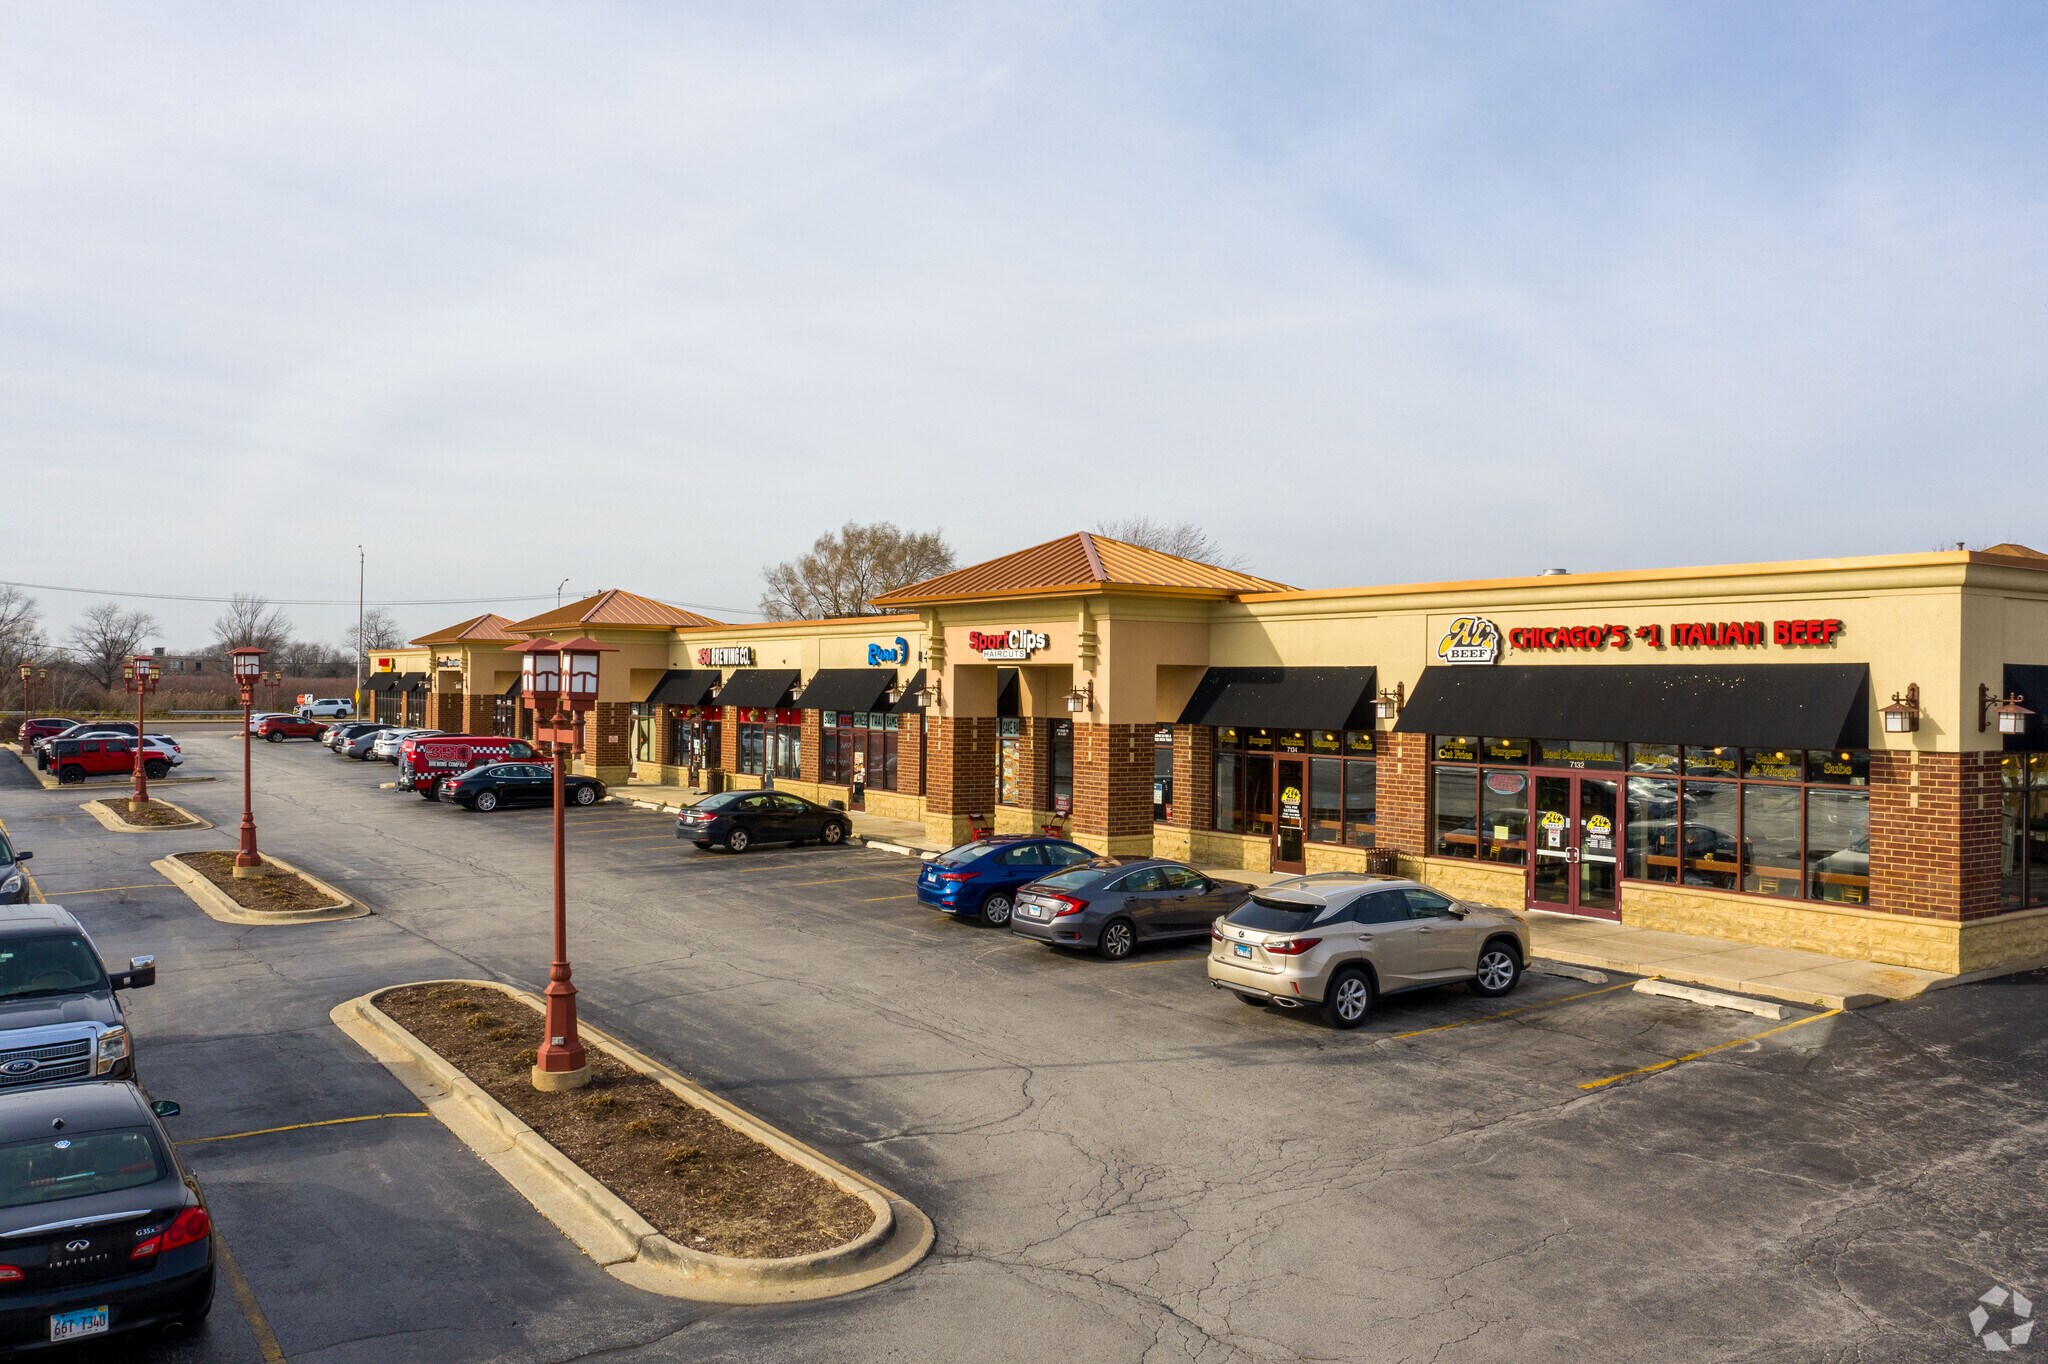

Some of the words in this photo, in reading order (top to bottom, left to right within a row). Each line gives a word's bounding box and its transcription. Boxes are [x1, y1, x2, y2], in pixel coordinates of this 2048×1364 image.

[1449, 617, 1495, 649] Al's
[1508, 624, 1626, 649] CHICAGO'S
[1634, 623, 1661, 647] #1
[1670, 620, 1761, 647] ITALIAN
[1773, 618, 1839, 645] BEEF
[711, 647, 739, 665] BREWING
[983, 650, 1025, 658] HAIRCUTS
[1450, 649, 1488, 659] BEEF
[871, 714, 883, 727] THAI
[886, 715, 898, 728] RAME
[1280, 736, 1304, 747] Chicken
[425, 743, 472, 761] 350
[1438, 749, 1453, 760] Cut
[1490, 746, 1522, 759] Burgers
[1542, 748, 1561, 760] Beef
[1562, 749, 1615, 762] Sandwiches
[1569, 761, 1585, 769] 7132
[1705, 756, 1735, 772] Dogs
[1823, 762, 1852, 775] Subs
[1750, 766, 1759, 776] &
[1762, 765, 1797, 780] Wraps
[11, 1062, 29, 1071] Ford
[49, 1253, 109, 1269] INFINITI
[54, 1319, 74, 1336] 667
[81, 1312, 106, 1331] 7340
